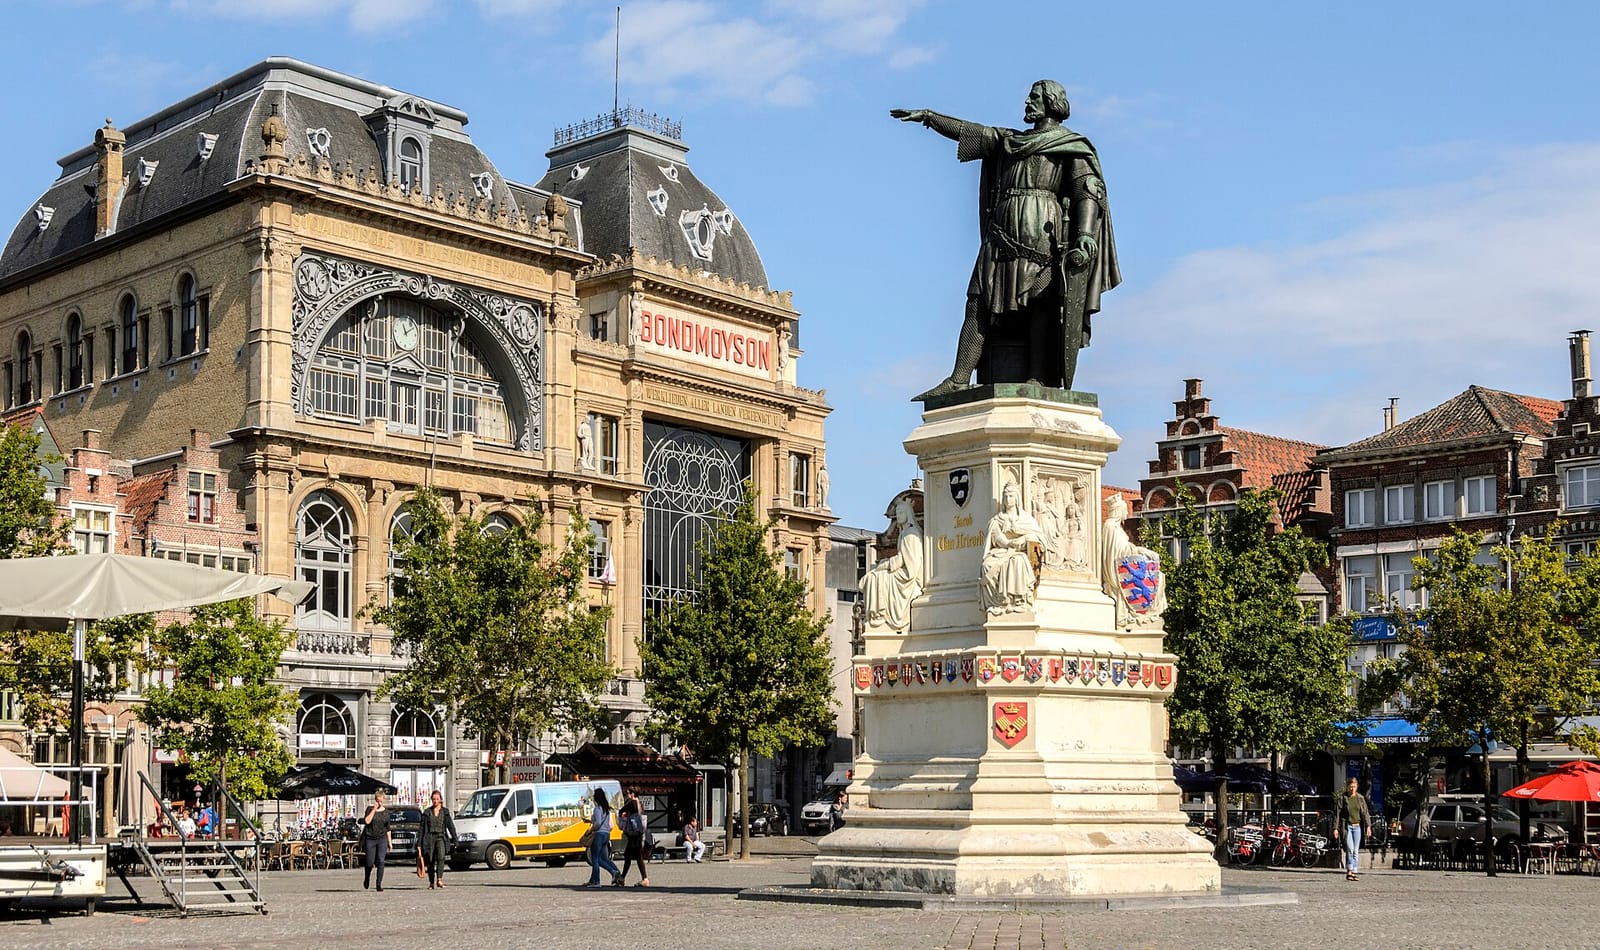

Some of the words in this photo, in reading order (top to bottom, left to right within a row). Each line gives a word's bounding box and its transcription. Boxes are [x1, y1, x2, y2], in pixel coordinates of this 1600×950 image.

[640, 310, 770, 371] BONDMOYSON
[511, 757, 540, 767] FRITUUR
[541, 806, 581, 818] schoon
